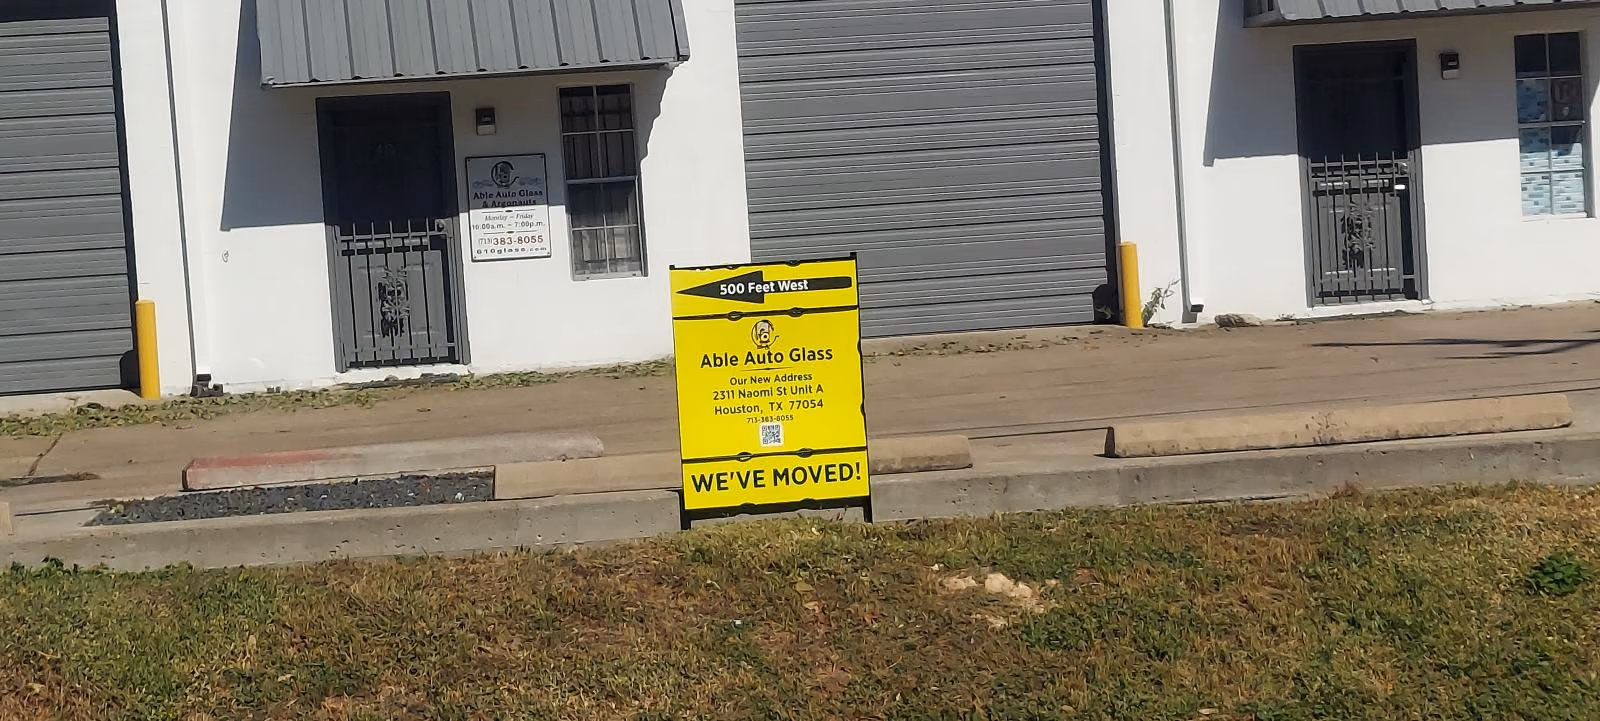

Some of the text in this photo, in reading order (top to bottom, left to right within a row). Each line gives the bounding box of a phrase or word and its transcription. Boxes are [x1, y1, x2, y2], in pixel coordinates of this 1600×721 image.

[474, 192, 494, 200] Able
[519, 189, 543, 197] Glass
[492, 200, 537, 208] Argonauts
[720, 280, 808, 295] 500 Feet West
[700, 348, 833, 368] Able Auto Glass
[730, 373, 812, 386] Our New Address
[713, 384, 824, 400] 2311 Naomi St Unit A
[714, 399, 824, 415] Houston, TX 77054
[692, 462, 861, 492] WE'VE MOVED!
